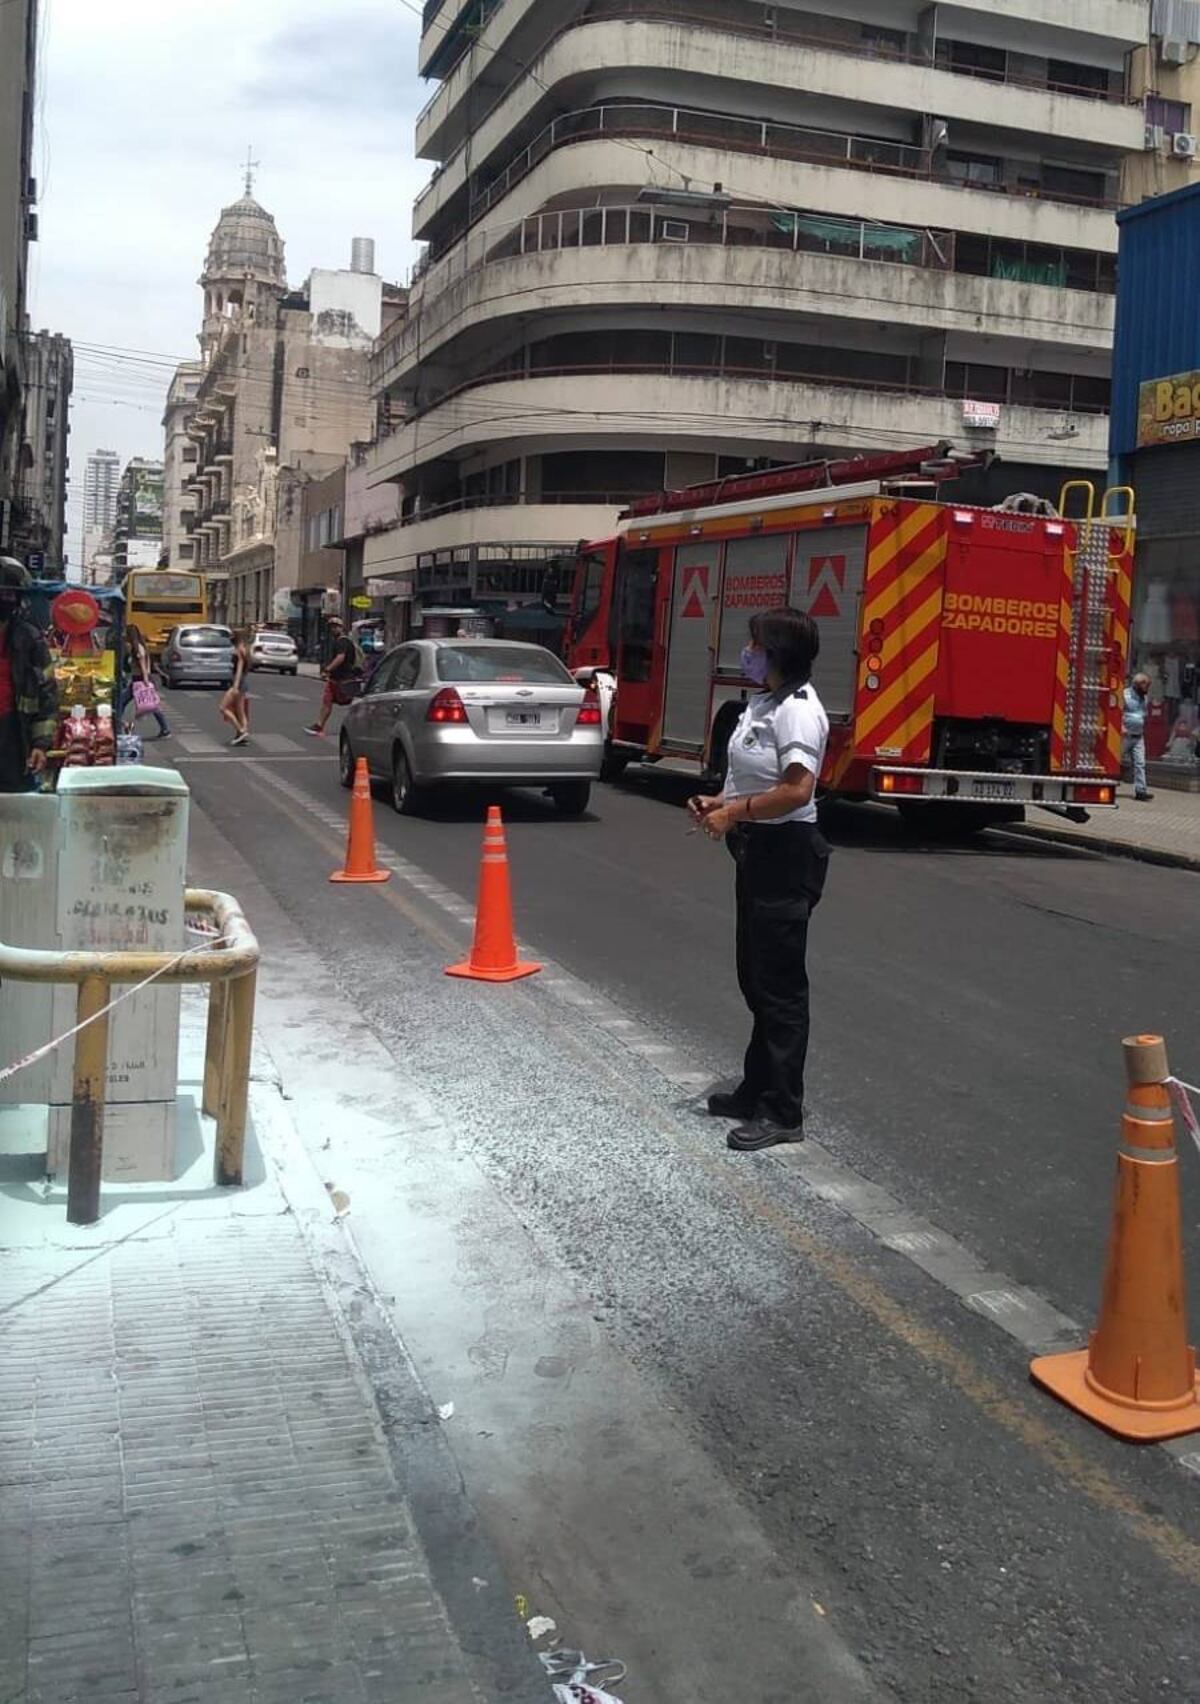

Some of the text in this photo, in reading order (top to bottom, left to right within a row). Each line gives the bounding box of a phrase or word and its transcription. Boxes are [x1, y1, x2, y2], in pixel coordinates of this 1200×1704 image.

[1163, 422, 1190, 437] ropa
[726, 574, 785, 591] BOMBEROS
[725, 593, 785, 608] ZAPADORES
[944, 593, 1059, 620] BOMBEROS
[941, 611, 1057, 638] ZAPADORES
